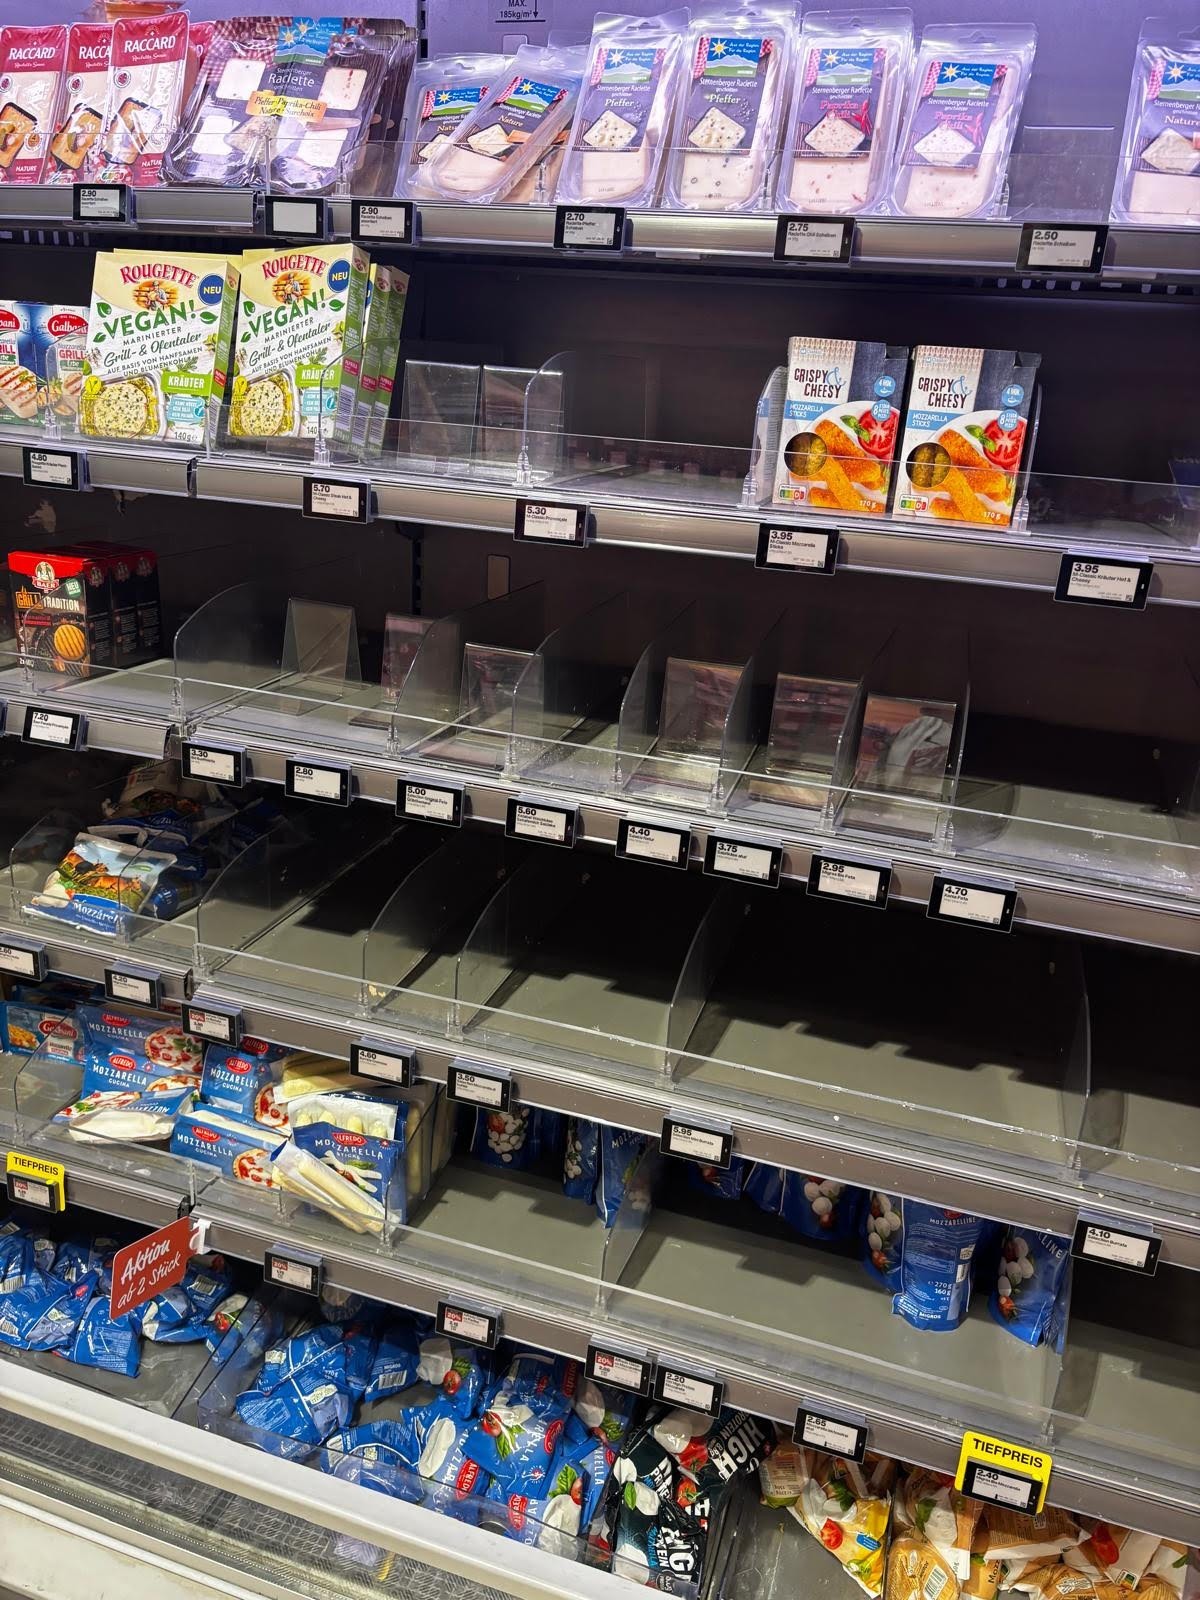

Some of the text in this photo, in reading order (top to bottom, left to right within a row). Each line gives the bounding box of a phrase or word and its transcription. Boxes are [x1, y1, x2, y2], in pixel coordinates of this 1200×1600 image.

[124, 35, 176, 54] RACCARD
[9, 46, 56, 60] RACCARD
[605, 99, 635, 107] Pfeffer
[709, 94, 741, 104] Pfeffer
[498, 115, 524, 127] Nature
[567, 213, 585, 221] 2.70
[789, 223, 808, 232] 2.75
[1034, 231, 1058, 240] 2.50
[262, 254, 326, 280] ROUGETTE
[120, 263, 198, 288] ROUGETTE
[332, 272, 348, 281] NEU
[203, 286, 222, 295] NEU
[248, 288, 326, 338] VEGAN!
[103, 299, 197, 339] VEGAN!
[264, 316, 314, 343] MARINIERTER
[123, 326, 182, 346] MARINIERTER
[249, 321, 331, 366] Grill- & Ofentaler
[103, 333, 202, 368] Grill- & Ofentaler
[252, 336, 332, 374] AUF BASIS VON HANFSAMEN
[107, 346, 203, 375] AUF BASIS VON HANFSAMEN
[123, 369, 138, 378] UND
[264, 366, 277, 374] UND
[168, 374, 205, 389] KRÄUTER
[794, 366, 846, 386] CRISPY &
[804, 383, 842, 398] CHEESY
[918, 376, 972, 396] CRISPY &
[928, 393, 967, 409] CHEESY
[789, 410, 807, 418] STICKS
[790, 404, 824, 413] MOZZARELLA
[873, 405, 878, 416] 8
[912, 420, 930, 428] STICKS
[913, 414, 948, 423] MOZZARELLA
[999, 415, 1005, 424] 8
[32, 453, 48, 462] 4.80
[313, 485, 330, 493] 5.70
[527, 506, 546, 515] 5.30
[983, 511, 1001, 520] 170 g
[771, 531, 793, 540] 3.95
[1074, 563, 1099, 574] 3.95
[66, 580, 80, 593] NEU
[34, 713, 49, 722] 7.20
[191, 749, 208, 758] 3.30
[296, 767, 314, 776] 2.80
[407, 786, 426, 796] 5.00
[518, 806, 536, 816] 5.60
[629, 827, 650, 836] 4.40
[718, 843, 738, 853] 3.75
[823, 862, 845, 873] 2.95
[945, 886, 968, 896] 4.70
[113, 975, 128, 983] 4.20
[89, 1022, 145, 1039] MOZZARELLA
[360, 1051, 377, 1060] 4.60
[113, 1057, 134, 1069] ALFREDO
[93, 1064, 147, 1086] MOZZARELLA
[210, 1068, 259, 1089] MOZZARELLA
[457, 1073, 475, 1083] 3.50
[108, 1078, 130, 1088] CUCINA
[222, 1082, 242, 1093] CUCINA
[673, 1126, 692, 1136] 5.95
[177, 1134, 233, 1157] MOZZARELLA
[314, 1139, 384, 1160] MOZZARELLA
[195, 1147, 218, 1158] CUCINA
[13, 1156, 59, 1176] TIEFPREIS
[1089, 1228, 1111, 1239] 4.10
[121, 1239, 171, 1286] Aktion
[117, 1251, 181, 1309] ab 2 Stück
[447, 1312, 462, 1321] 20%
[597, 1356, 614, 1366] 20%
[666, 1373, 685, 1384] 2.20
[807, 1415, 827, 1427] 2.65
[711, 1417, 767, 1482] HIGH
[973, 1438, 1043, 1468] TIEFPREIS
[976, 1469, 999, 1481] 2.40
